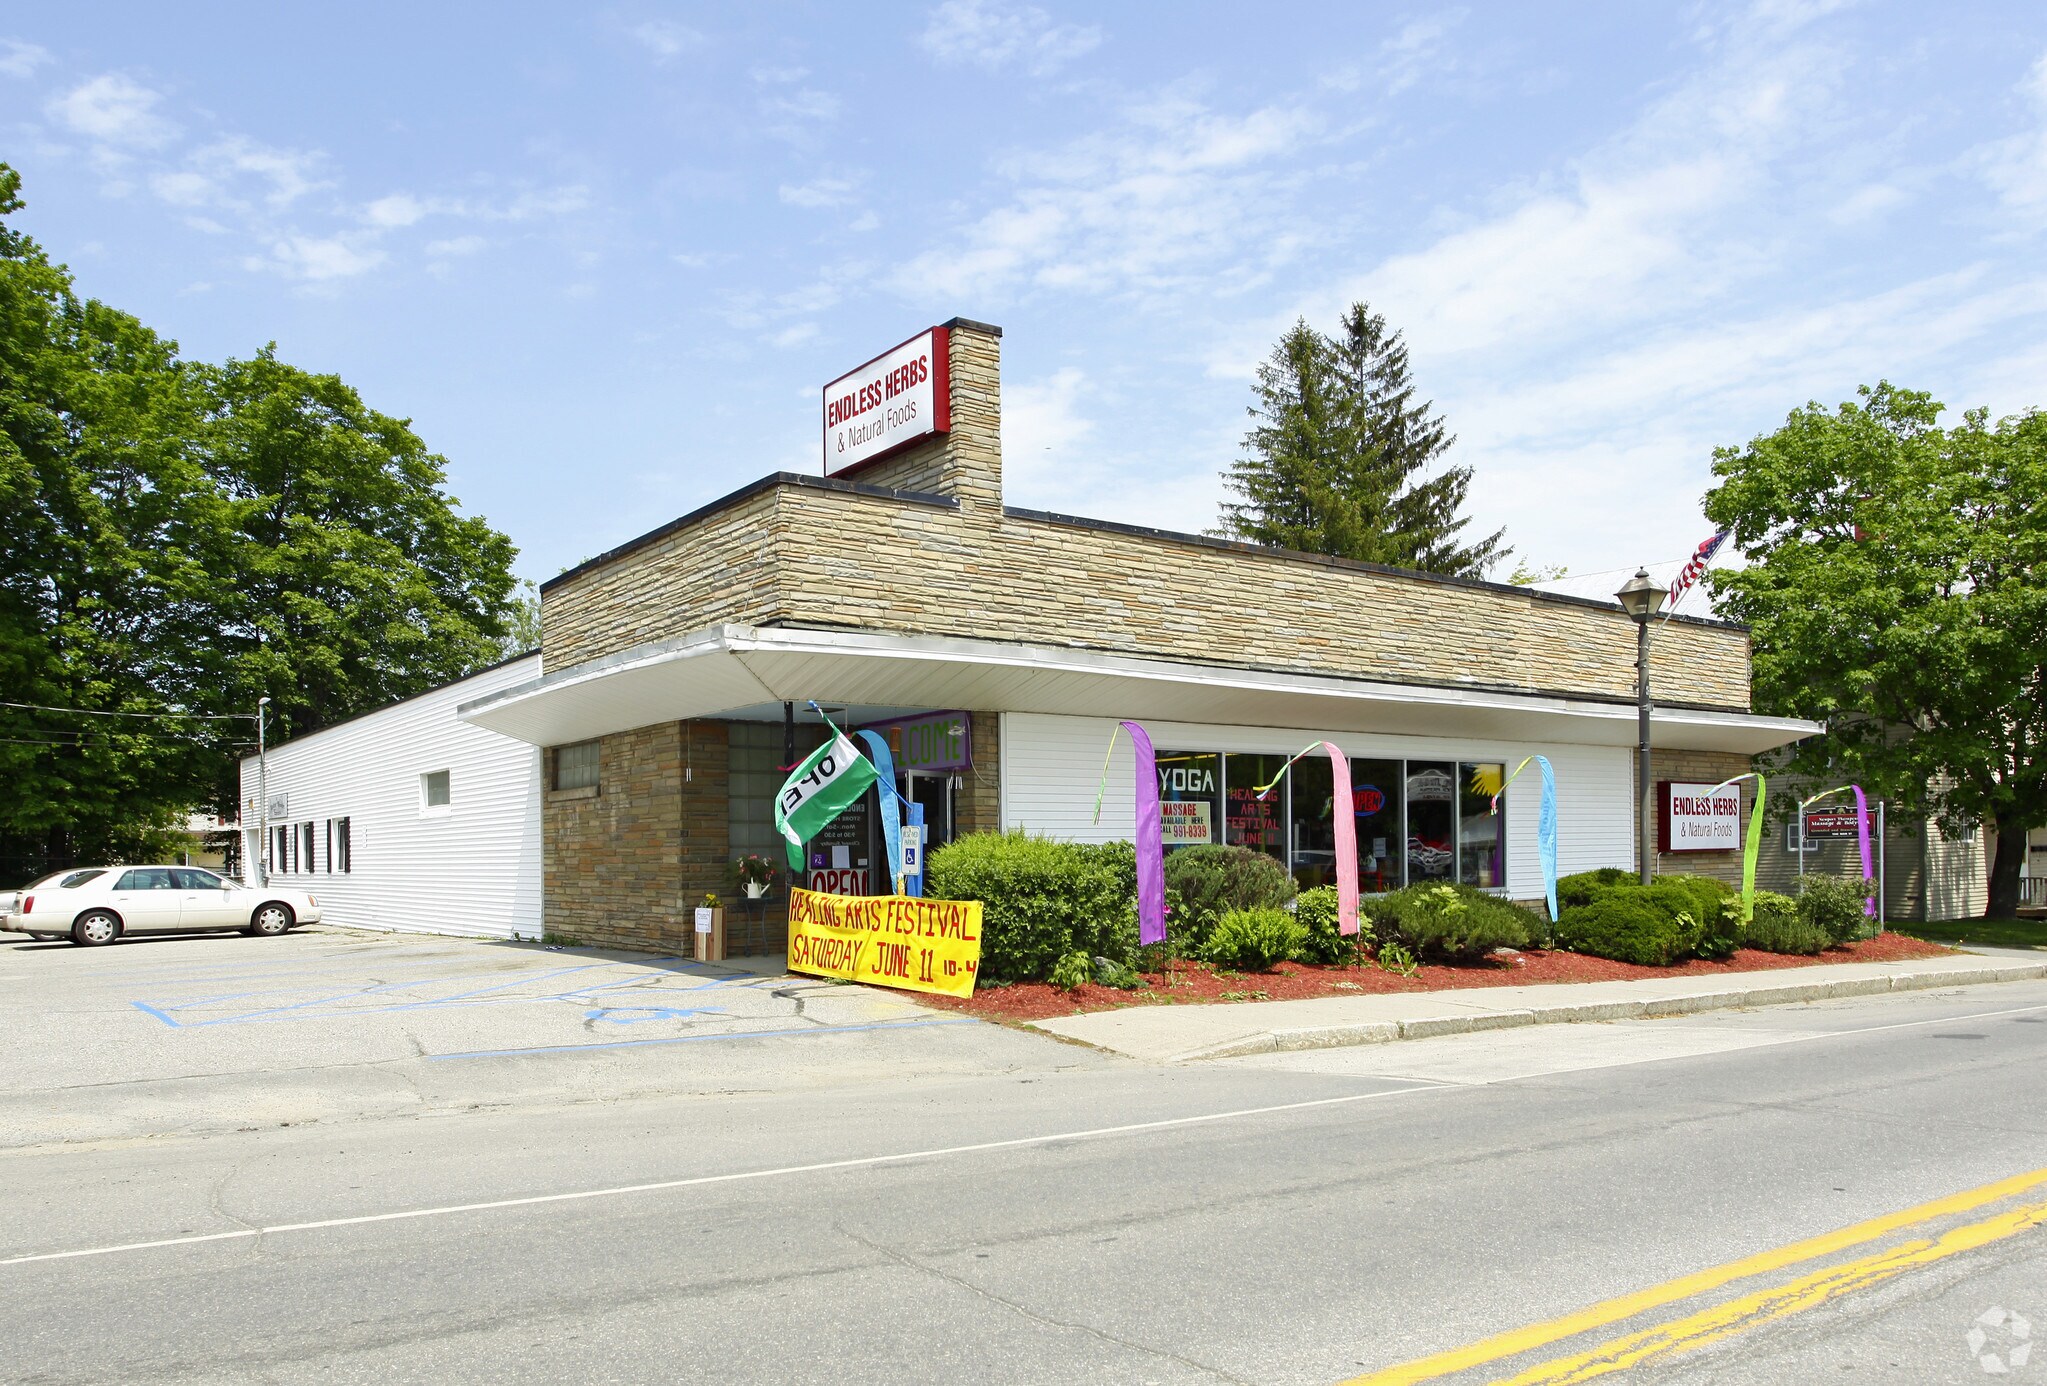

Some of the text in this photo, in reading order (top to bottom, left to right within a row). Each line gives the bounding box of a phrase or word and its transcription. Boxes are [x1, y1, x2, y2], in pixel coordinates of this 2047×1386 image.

[828, 355, 928, 429] ENDLESS HERBS
[837, 398, 917, 453] & Natural Foods
[1158, 768, 1214, 792] YOGA
[1230, 788, 1278, 802] HEALNG
[1162, 803, 1197, 816] MASSAGE
[1241, 803, 1271, 816] ARTS
[1673, 796, 1738, 816] ENDLESS HERBS
[1191, 816, 1204, 825] HERE
[1681, 821, 1733, 838] & Natural Foods
[1173, 825, 1207, 838] 991-8339
[1234, 831, 1265, 845] JUNE
[812, 870, 868, 896] OPEN
[790, 889, 977, 941] HEALING ARTS FESTIVAL
[792, 933, 863, 972] SATURDAY
[872, 941, 911, 979] JUNE
[918, 948, 934, 983] 11
